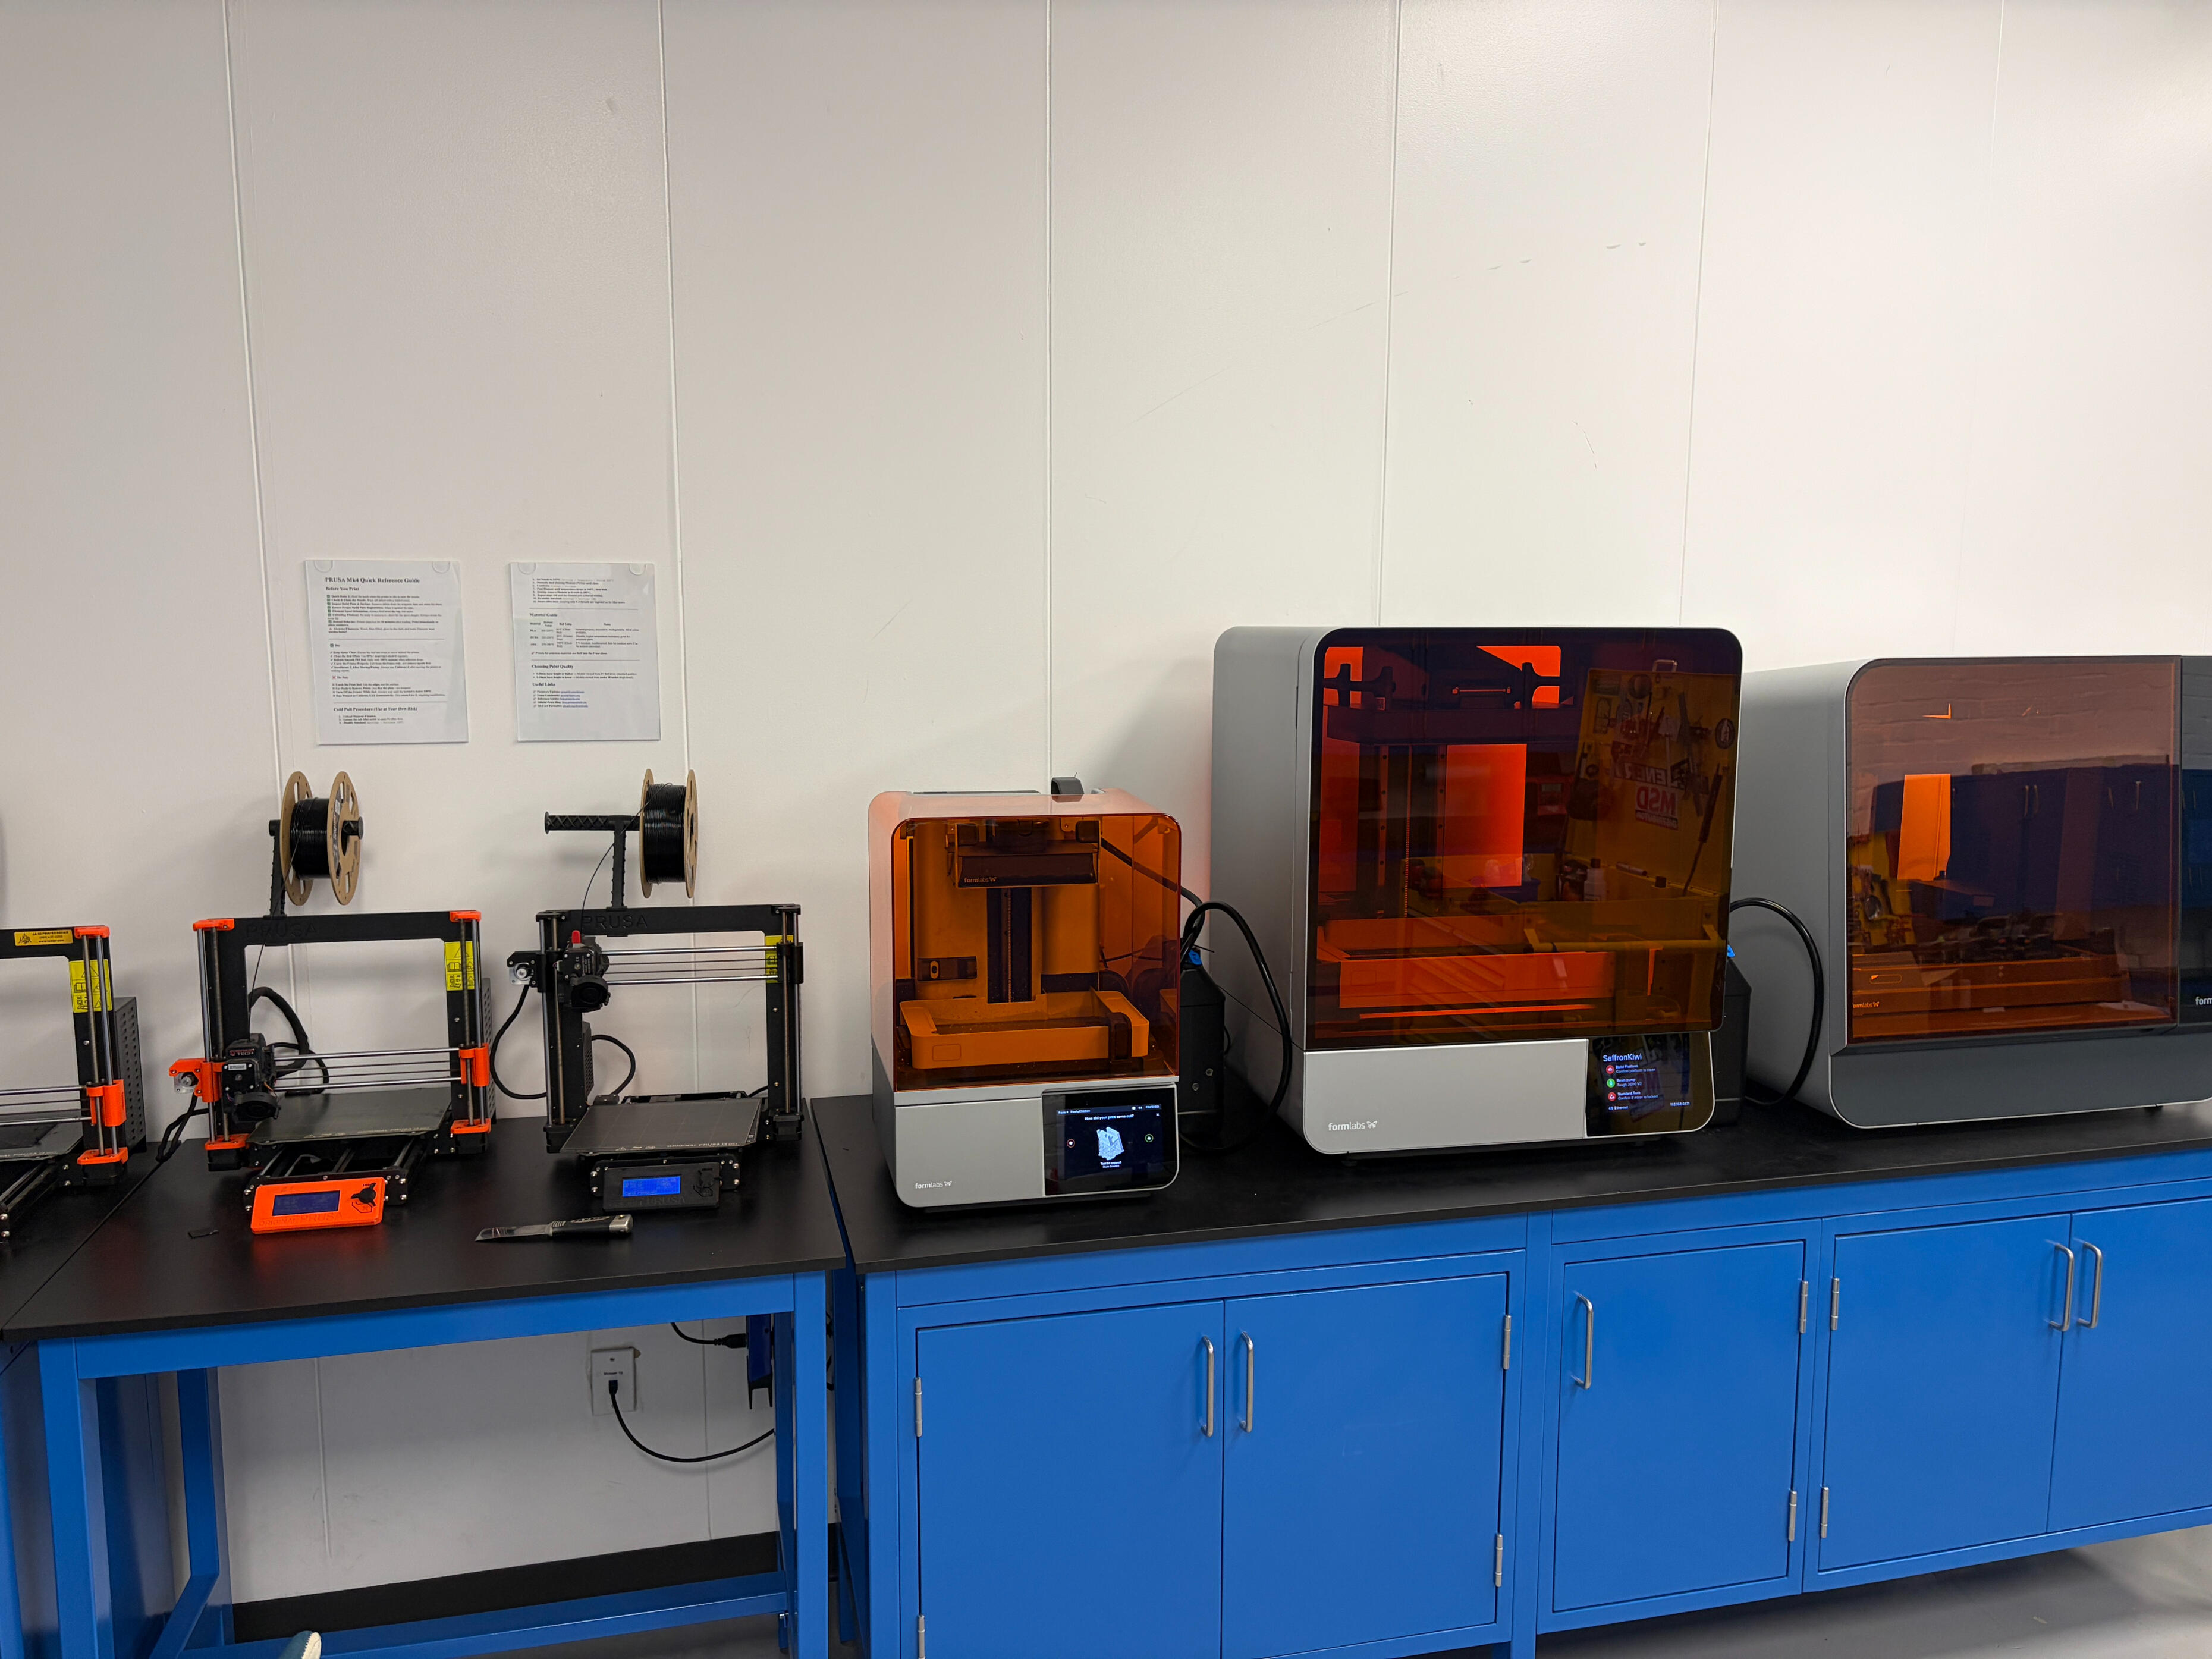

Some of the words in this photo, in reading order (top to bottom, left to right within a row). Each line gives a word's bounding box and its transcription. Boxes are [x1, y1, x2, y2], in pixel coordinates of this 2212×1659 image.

[582, 915, 648, 929] PRUSA
[1603, 1053, 1642, 1062] SaffronKiwi
[1328, 1121, 1366, 1131] formlabs
[300, 1212, 343, 1222] PRUSA
